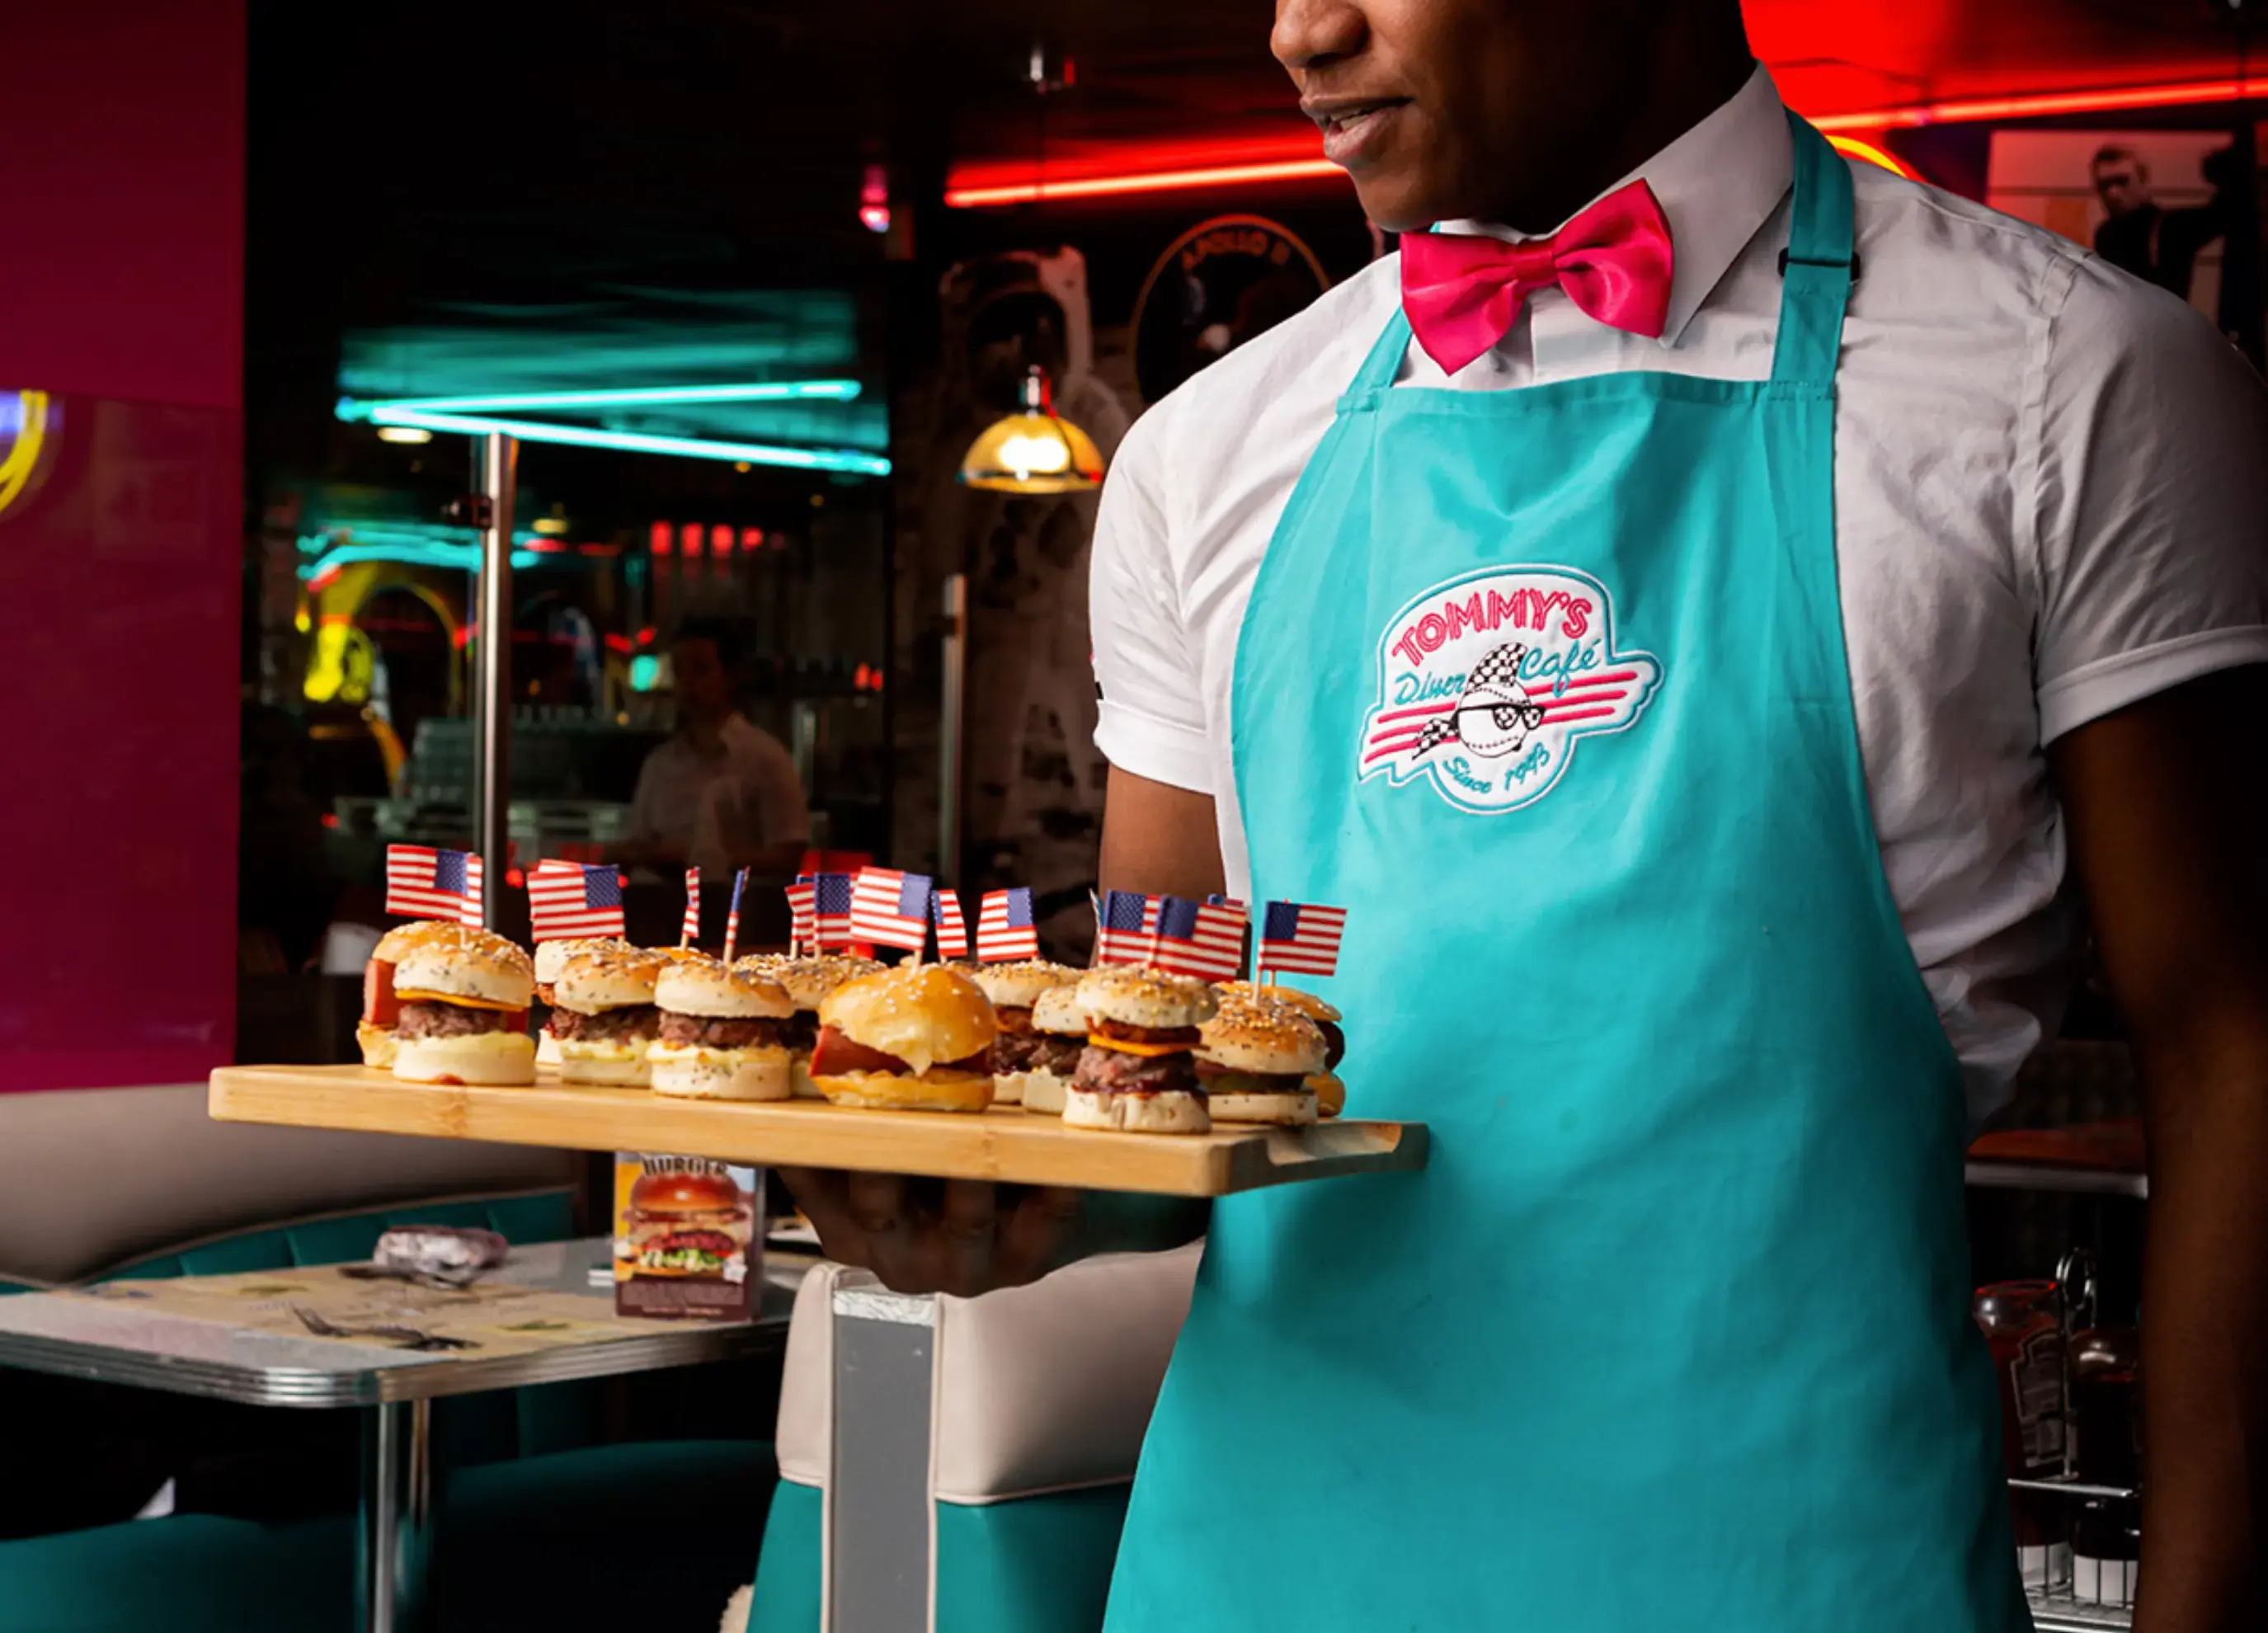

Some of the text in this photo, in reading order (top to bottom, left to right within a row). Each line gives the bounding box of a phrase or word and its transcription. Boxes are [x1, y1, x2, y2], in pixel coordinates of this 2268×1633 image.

[1392, 588, 1593, 667] TOMMY'S
[1395, 638, 1603, 705] Diner Café
[1442, 741, 1550, 794] Since 1993
